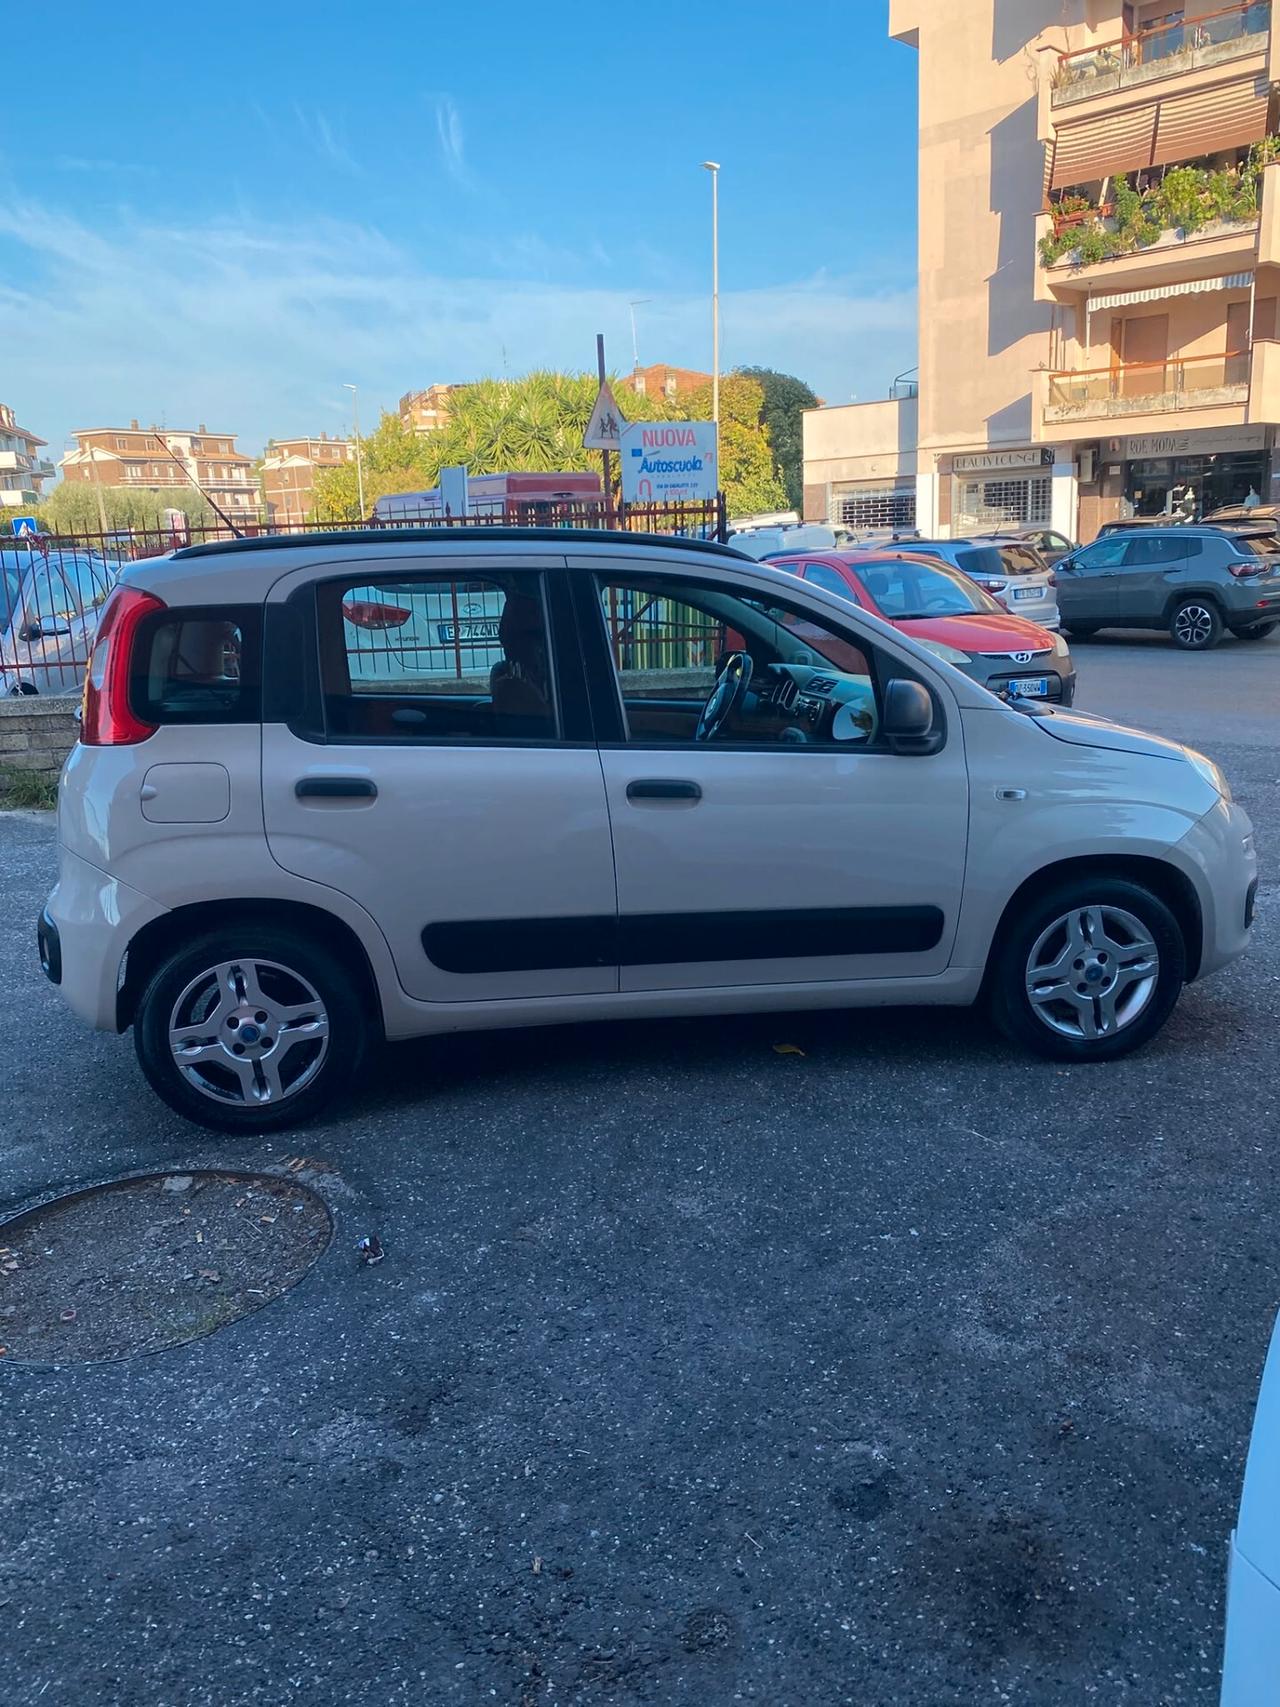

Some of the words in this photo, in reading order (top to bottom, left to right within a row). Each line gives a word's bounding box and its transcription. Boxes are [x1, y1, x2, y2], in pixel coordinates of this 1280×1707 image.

[642, 429, 696, 447] NUOVA
[637, 455, 703, 474] Autoscuola
[956, 455, 992, 469] BEAUTY
[995, 452, 1036, 466] LOUNGE
